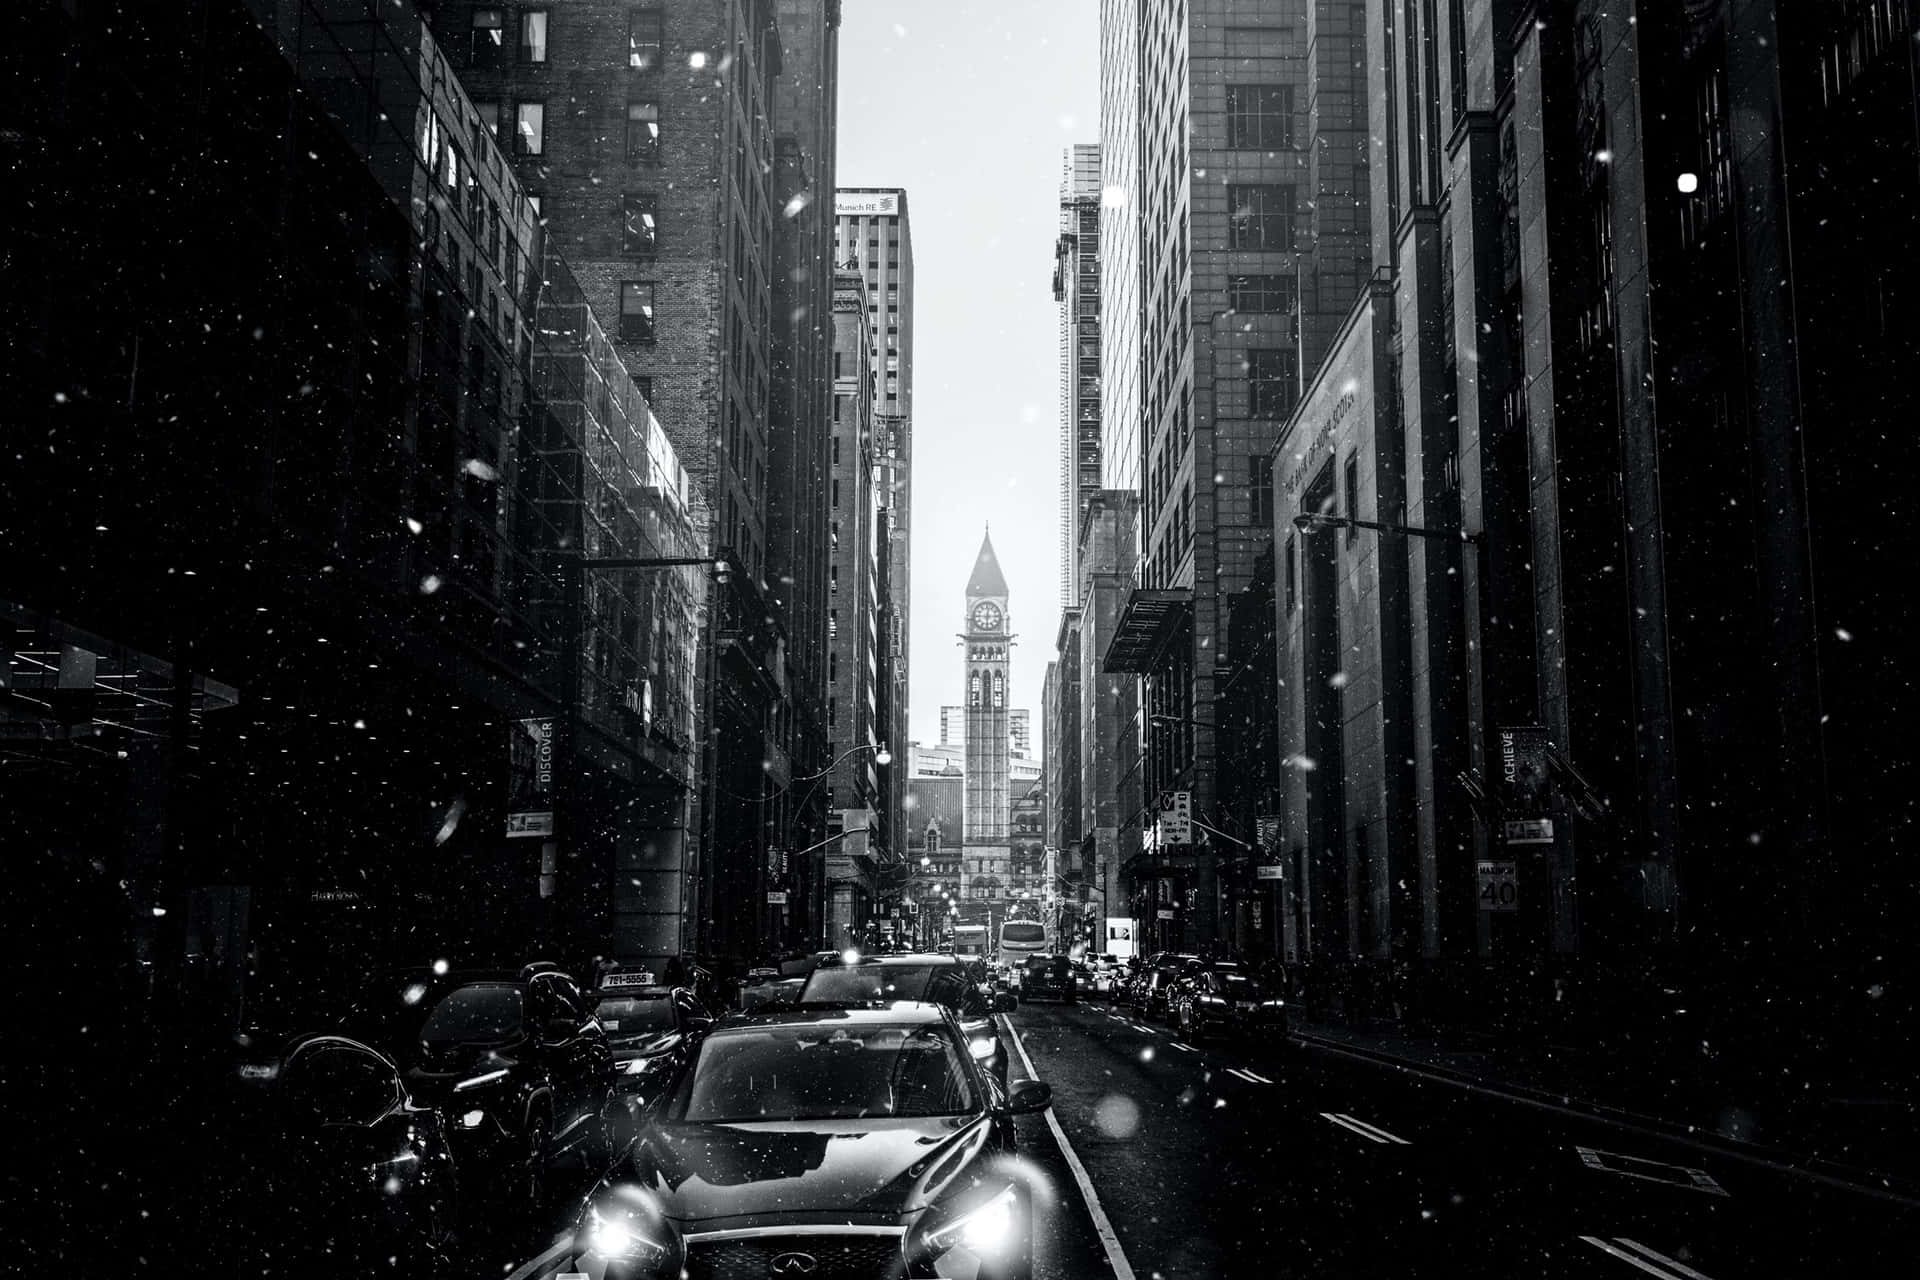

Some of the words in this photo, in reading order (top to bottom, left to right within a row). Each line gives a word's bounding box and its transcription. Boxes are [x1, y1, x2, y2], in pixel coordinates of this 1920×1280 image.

[865, 203, 876, 211] RE
[540, 722, 553, 783] DISCOVER
[1503, 731, 1516, 783] ACHIEVE
[1481, 882, 1515, 905] 40
